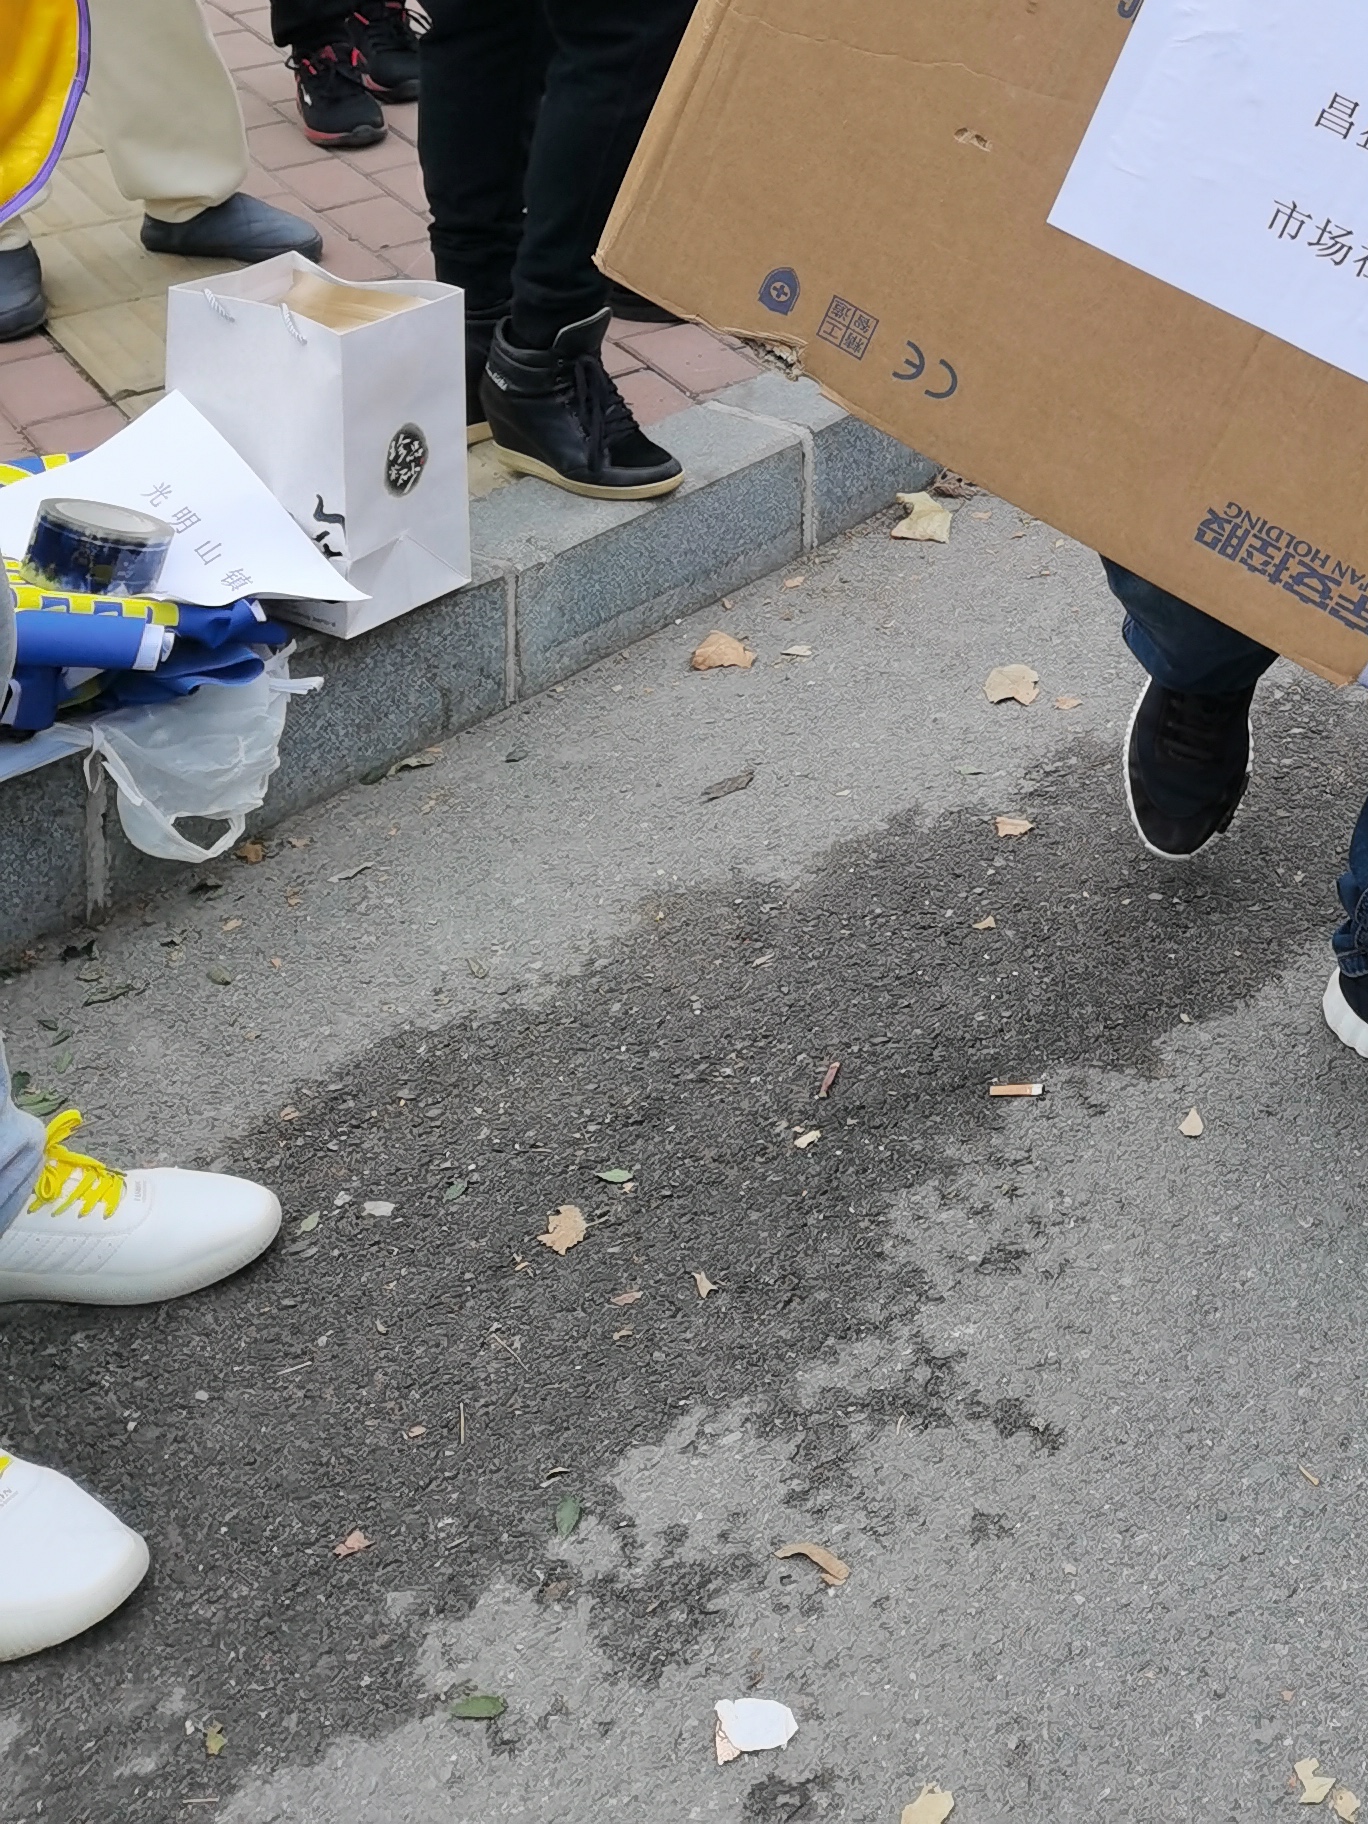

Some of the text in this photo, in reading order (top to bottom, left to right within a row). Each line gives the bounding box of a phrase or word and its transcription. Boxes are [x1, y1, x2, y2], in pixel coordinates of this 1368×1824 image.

[891, 339, 958, 399] CE
[140, 482, 254, 592] 光明山镇
[1223, 501, 1331, 569] HOLDING
